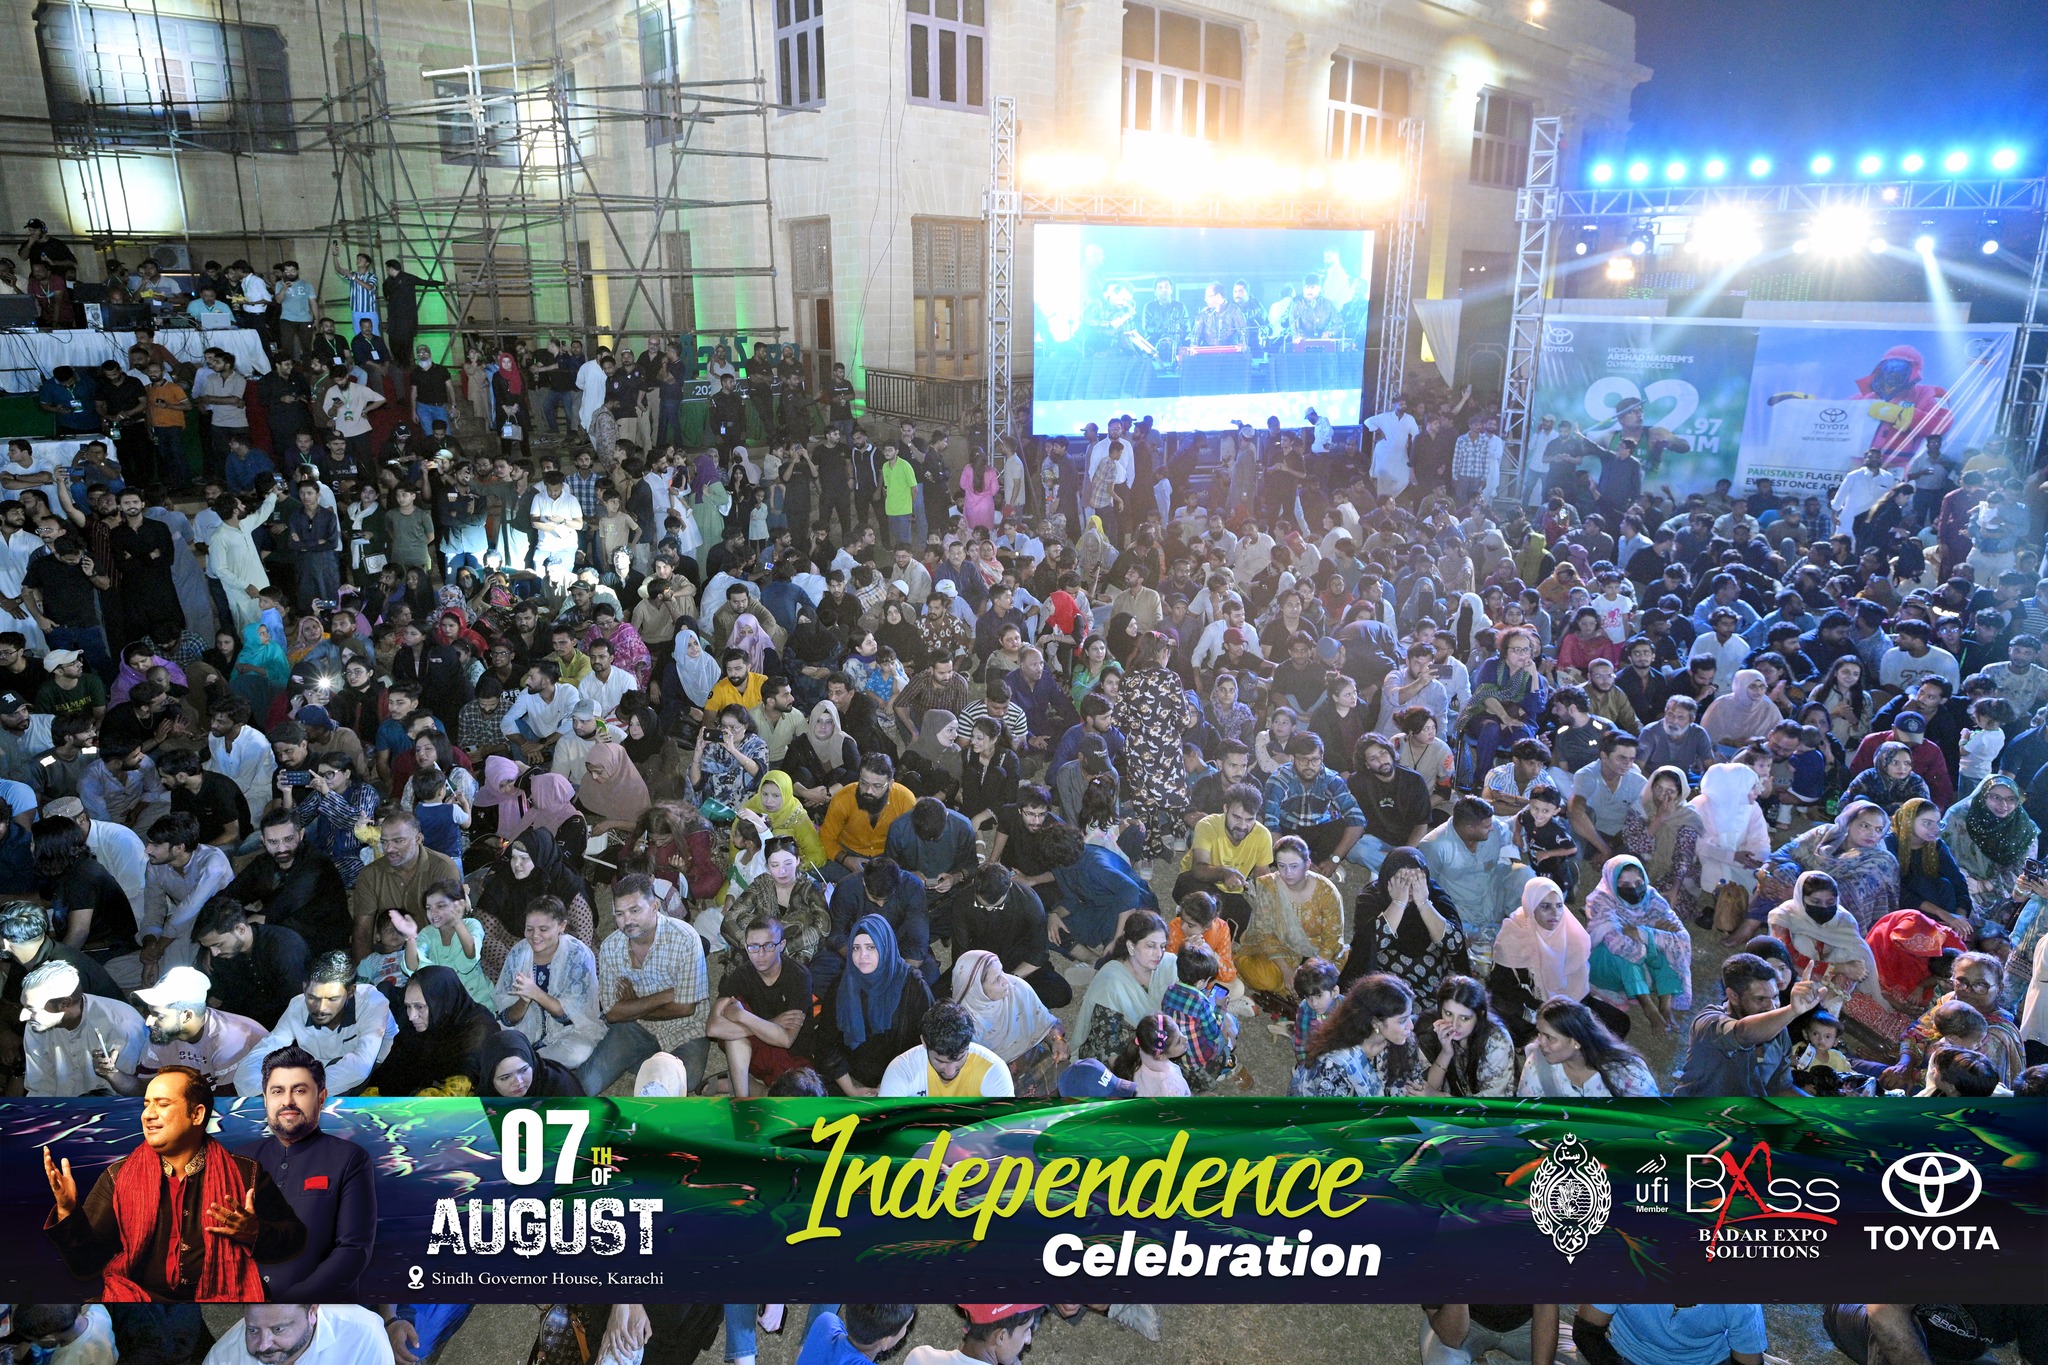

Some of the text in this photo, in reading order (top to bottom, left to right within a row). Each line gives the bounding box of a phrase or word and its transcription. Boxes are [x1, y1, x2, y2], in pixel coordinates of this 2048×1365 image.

[1607, 347, 1654, 355] HONORING
[1607, 353, 1695, 364] ARSHAD NADEEM'S
[1641, 362, 1675, 370] SUCCESS
[1747, 468, 1804, 479] PAKISTAN'S
[1805, 472, 1832, 481] FLAG
[1745, 477, 1788, 488] EVEST
[1788, 480, 1818, 490] ONCE
[1931, 1313, 1993, 1344] BROOKYN
